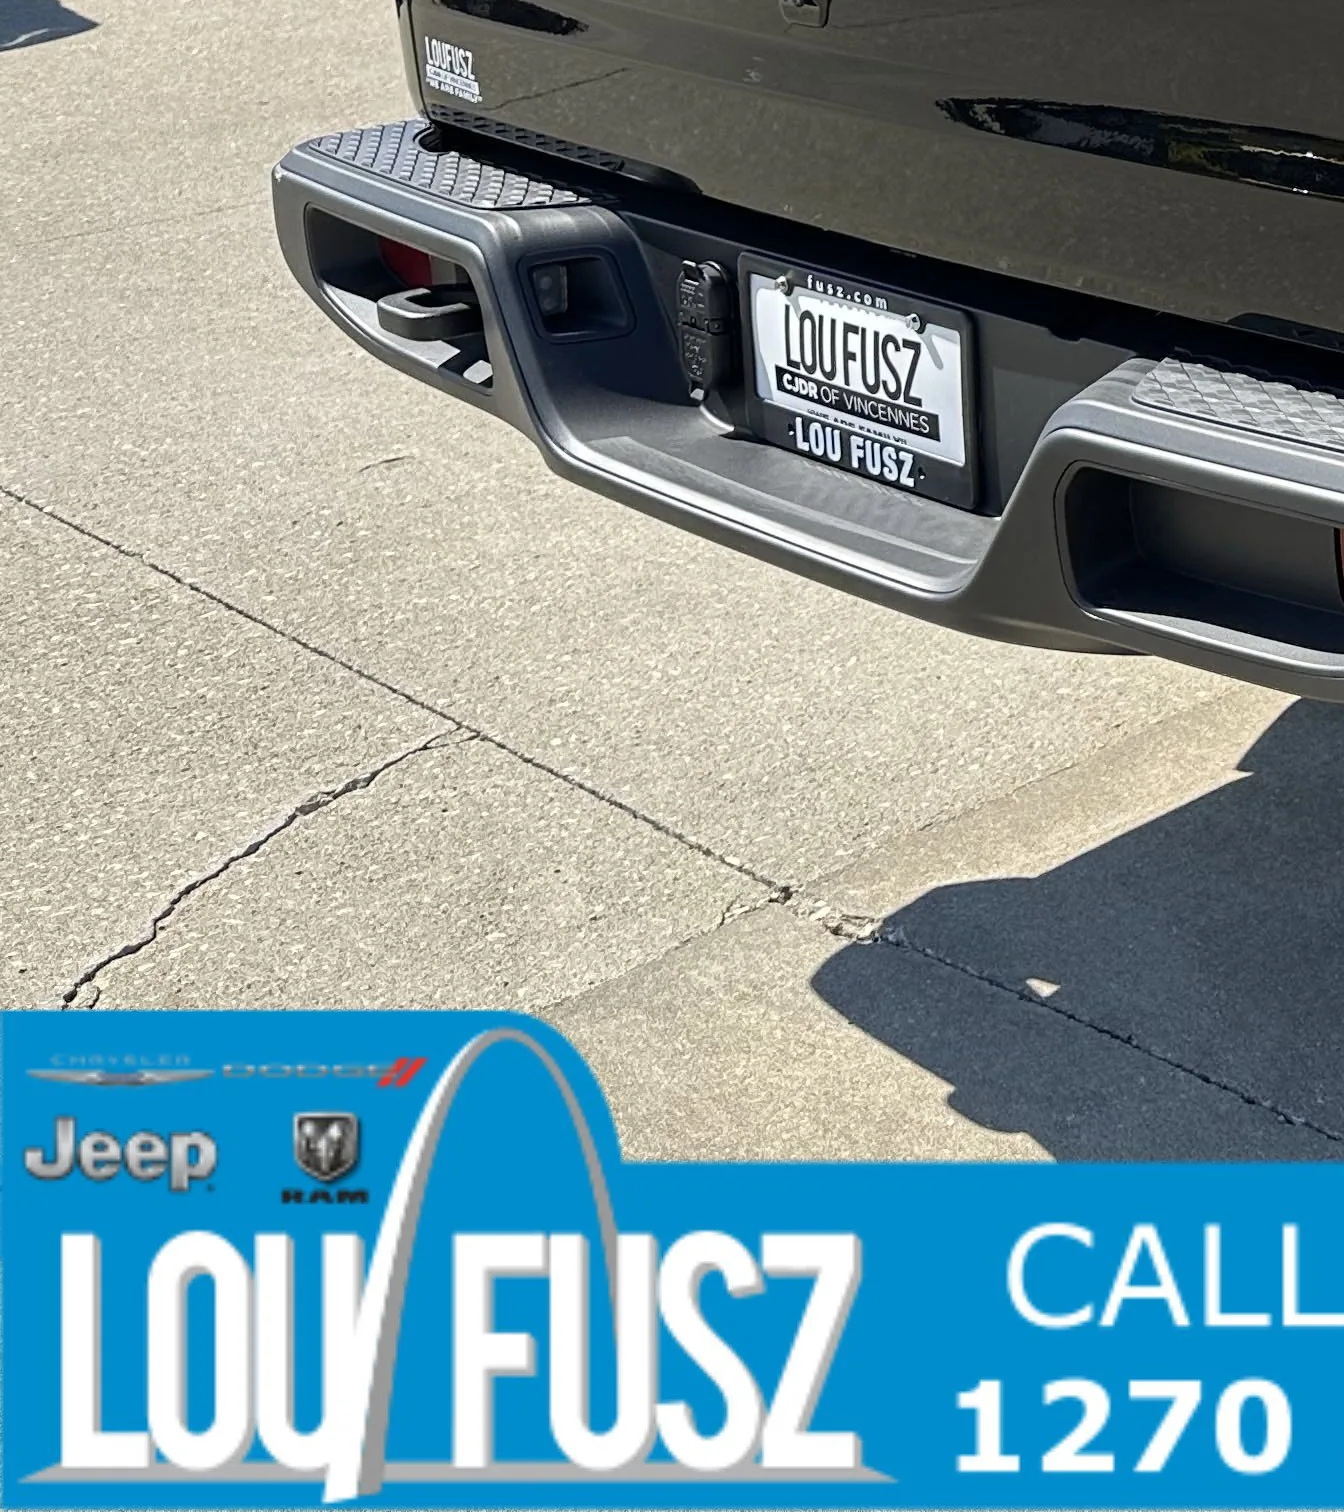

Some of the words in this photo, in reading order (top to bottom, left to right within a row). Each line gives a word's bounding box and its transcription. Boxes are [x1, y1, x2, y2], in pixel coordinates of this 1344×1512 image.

[806, 275, 889, 310] fusz.com
[782, 372, 819, 400] CJDR
[820, 386, 840, 406] OF
[842, 392, 931, 434] VINCENNES
[795, 416, 842, 462] LOU
[850, 434, 915, 488] FUSZ
